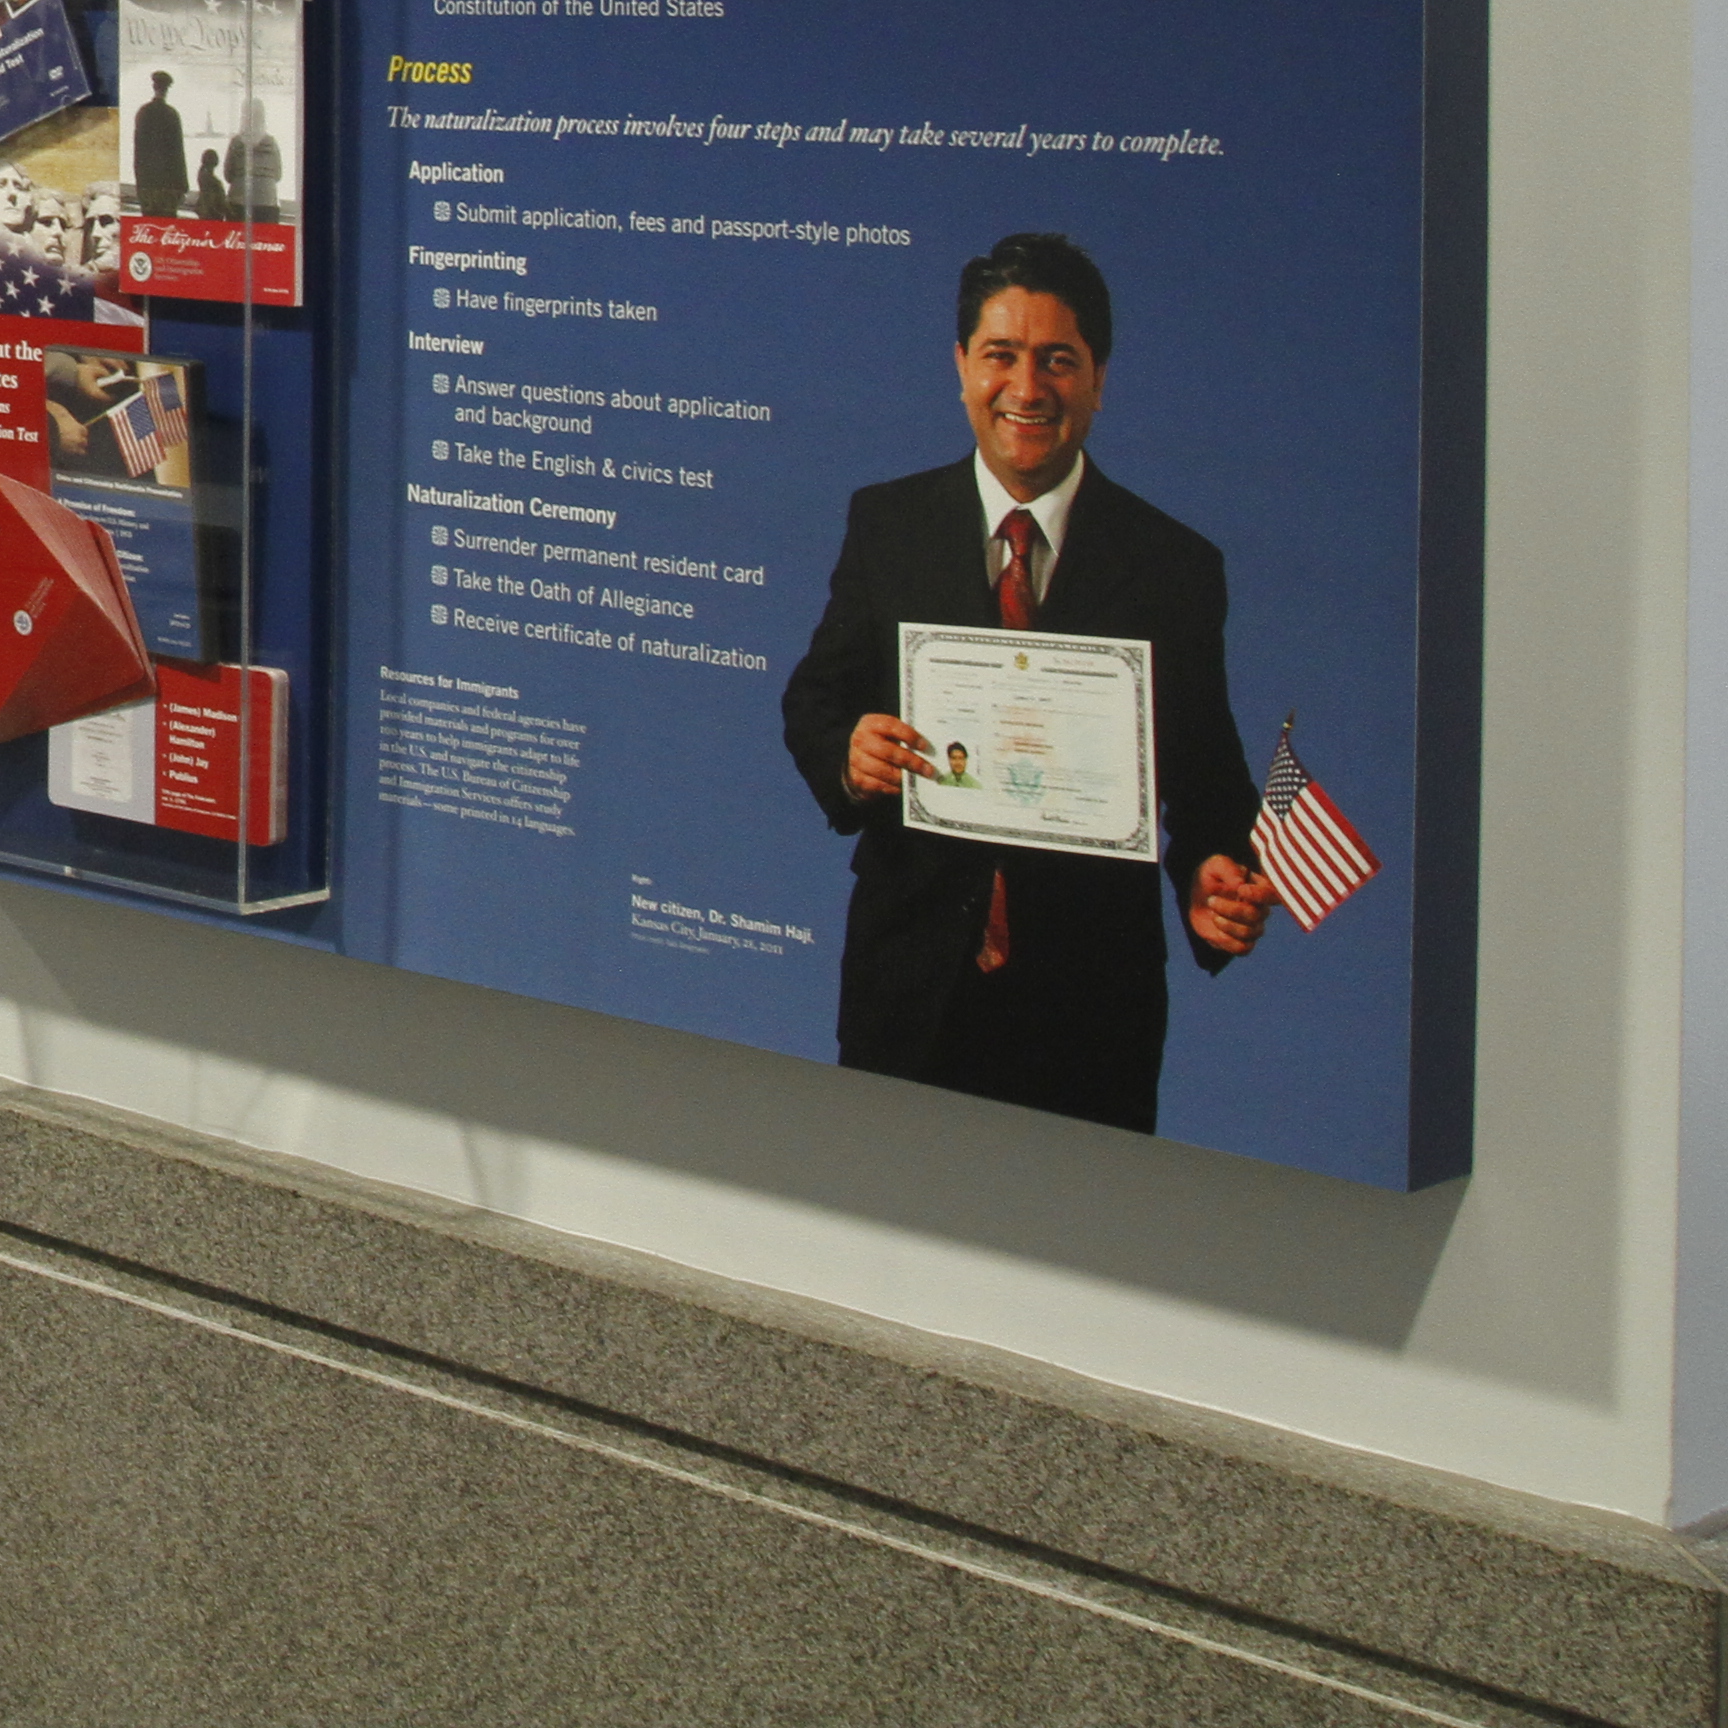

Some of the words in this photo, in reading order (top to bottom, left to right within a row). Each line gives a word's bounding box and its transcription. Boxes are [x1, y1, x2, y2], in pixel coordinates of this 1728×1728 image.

[5, 53, 24, 70] Test
[388, 55, 472, 84] Process
[389, 105, 421, 129] The
[423, 108, 553, 133] naturalization
[552, 115, 620, 141] process
[622, 113, 705, 138] involves
[703, 113, 753, 146] four
[753, 121, 802, 149] steps
[804, 118, 848, 143] and
[848, 127, 895, 152] may
[898, 121, 945, 146] take
[948, 124, 1027, 149] several
[1026, 132, 1088, 157] years
[1091, 131, 1115, 152] to
[1119, 128, 1224, 162] complete.
[409, 160, 504, 185] Application
[456, 202, 517, 225] Submit
[522, 207, 623, 233] application,
[629, 210, 666, 233] fees
[671, 214, 705, 235] and
[711, 219, 840, 245] passport-style
[846, 223, 911, 247] photos
[409, 245, 527, 276] Fingerprinting
[15, 340, 43, 362] the
[409, 330, 484, 355] Interview
[16, 426, 39, 443] Test
[407, 483, 524, 515] Naturalization
[529, 497, 617, 530] Ceremony
[631, 894, 658, 911] New
[660, 901, 705, 922] citizen,
[708, 909, 726, 925] Dr.
[730, 913, 782, 935] Shamim
